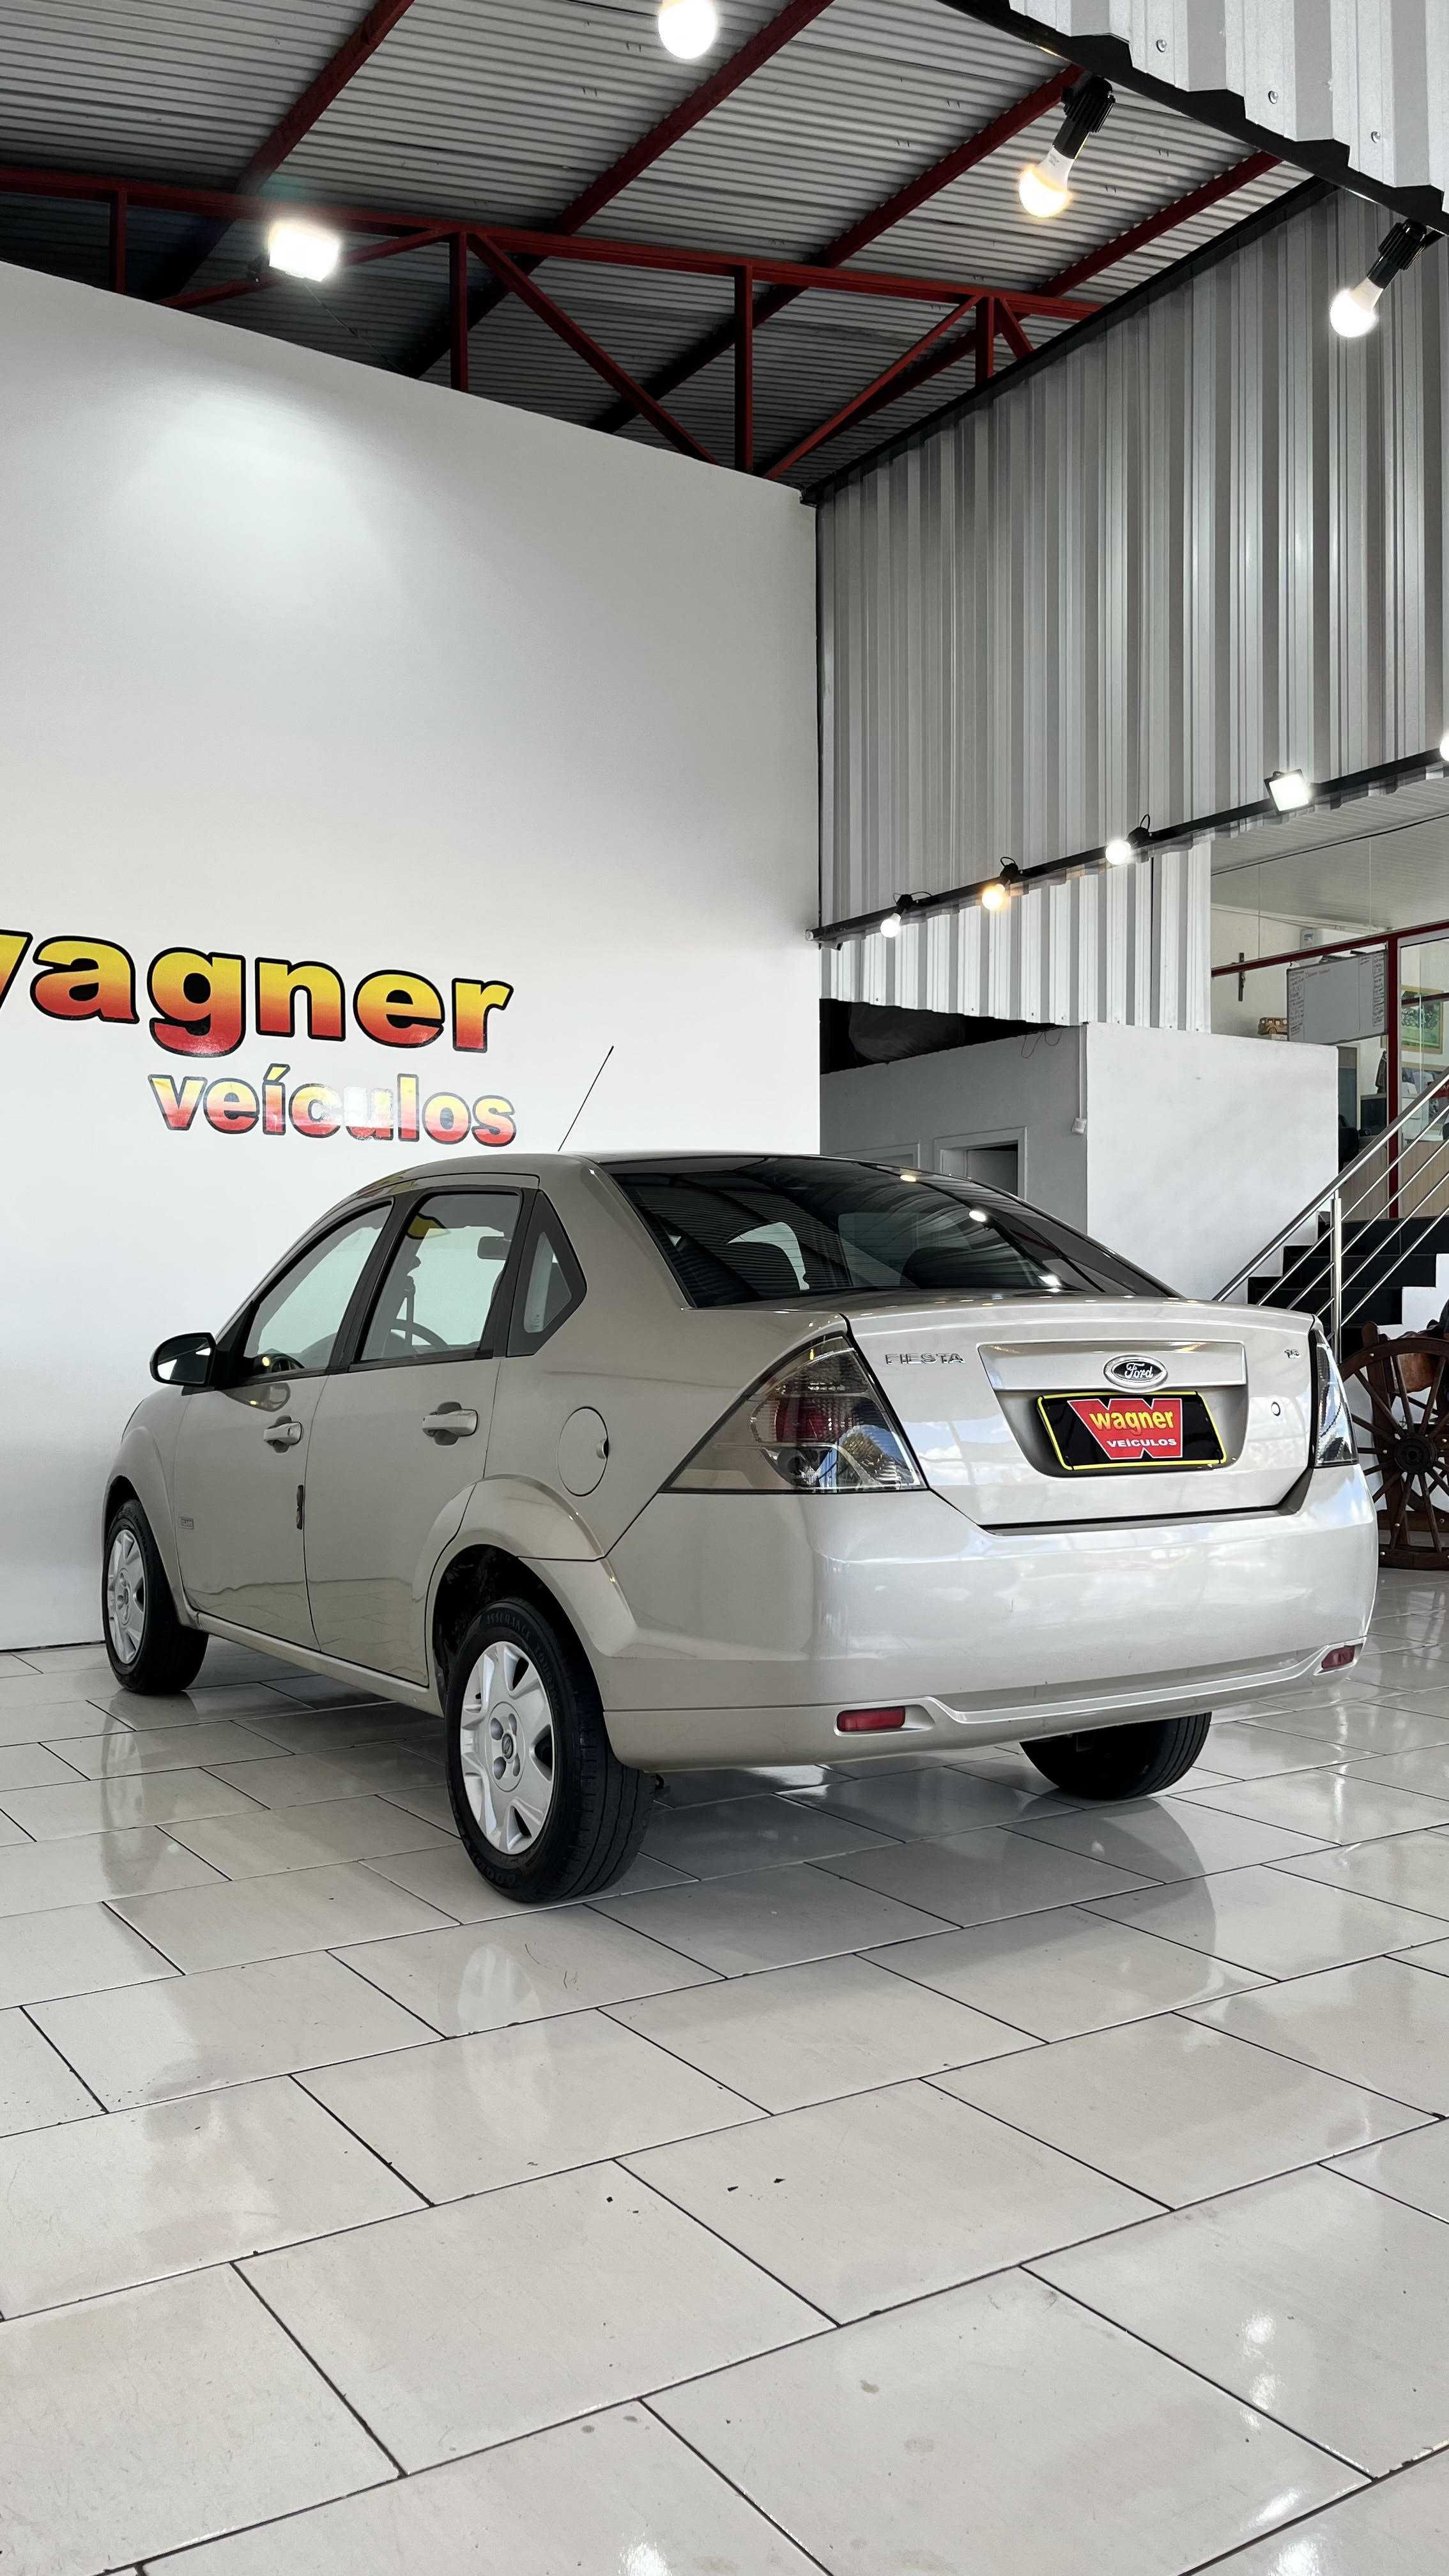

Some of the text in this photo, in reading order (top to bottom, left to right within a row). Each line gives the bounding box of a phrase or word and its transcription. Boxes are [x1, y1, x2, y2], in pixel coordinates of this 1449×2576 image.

[0, 930, 514, 1058] agner
[148, 1063, 518, 1147] veículos
[884, 1353, 966, 1365] FIESTA
[1124, 1362, 1154, 1379] Ford
[1088, 1410, 1174, 1436] wagner
